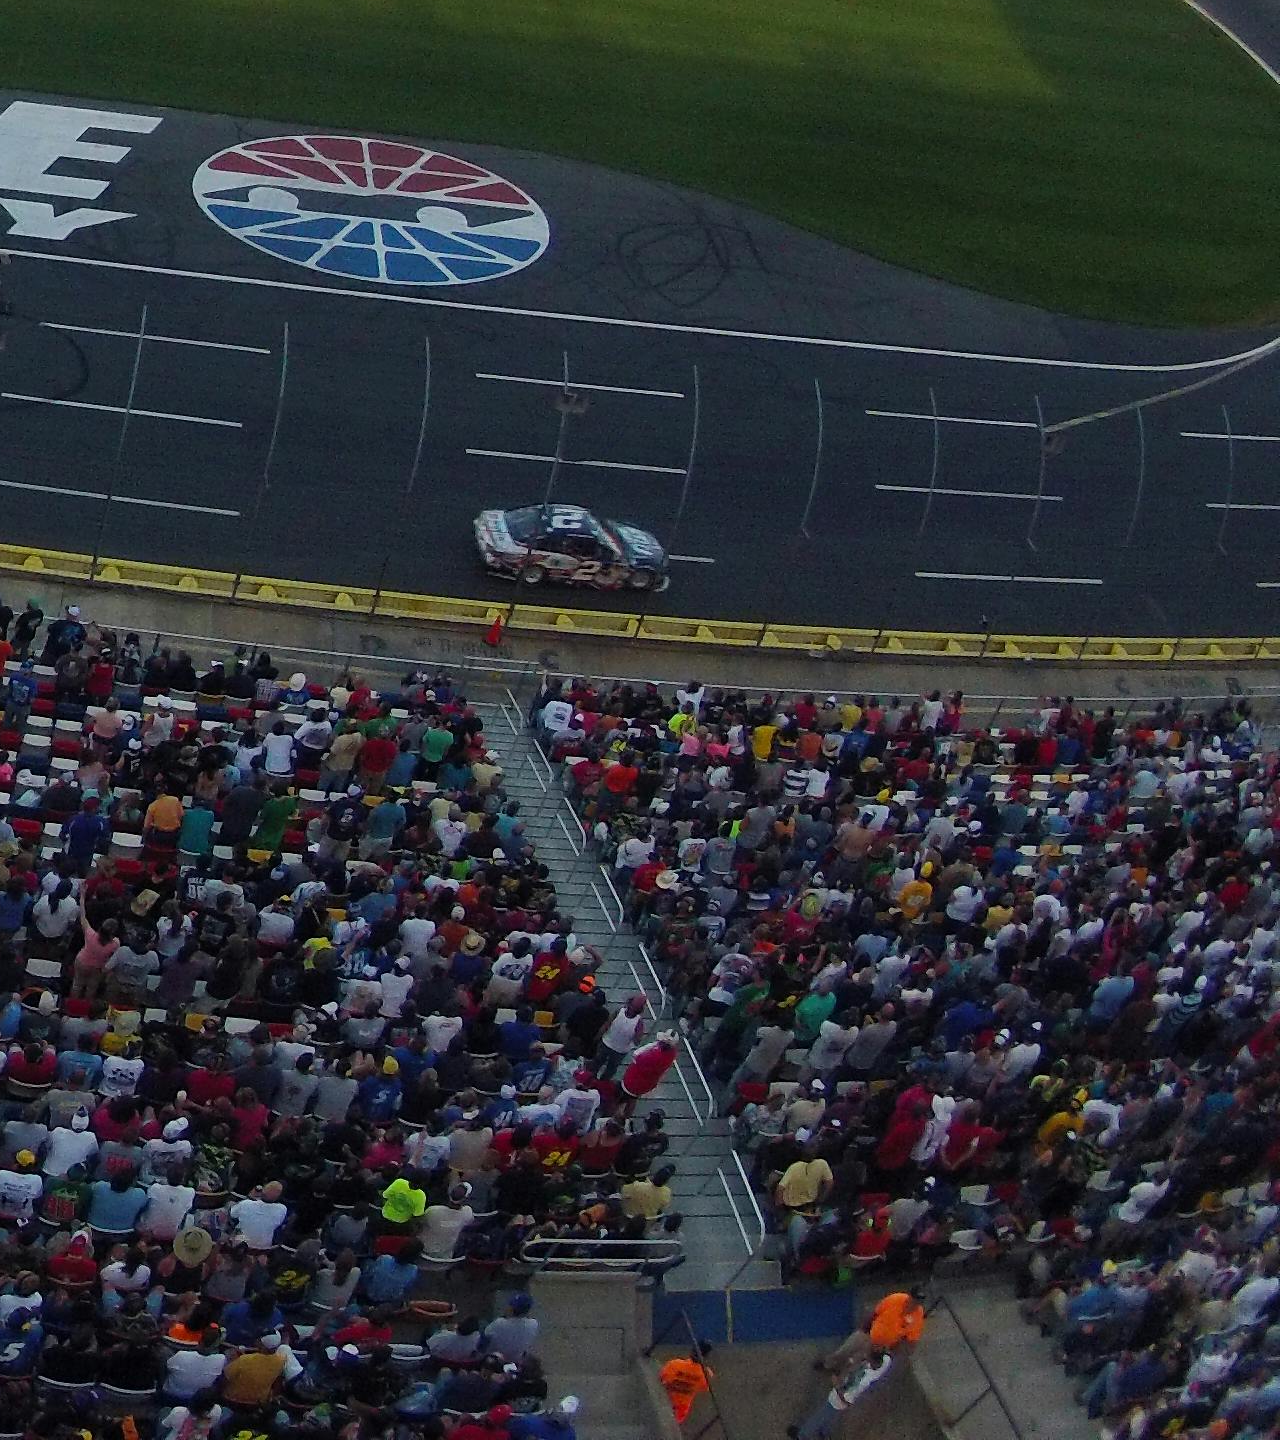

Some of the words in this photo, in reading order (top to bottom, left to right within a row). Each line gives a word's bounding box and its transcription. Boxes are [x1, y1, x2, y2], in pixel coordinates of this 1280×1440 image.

[571, 561, 602, 581] 2
[534, 965, 561, 981] 24
[541, 1151, 573, 1168] 24
